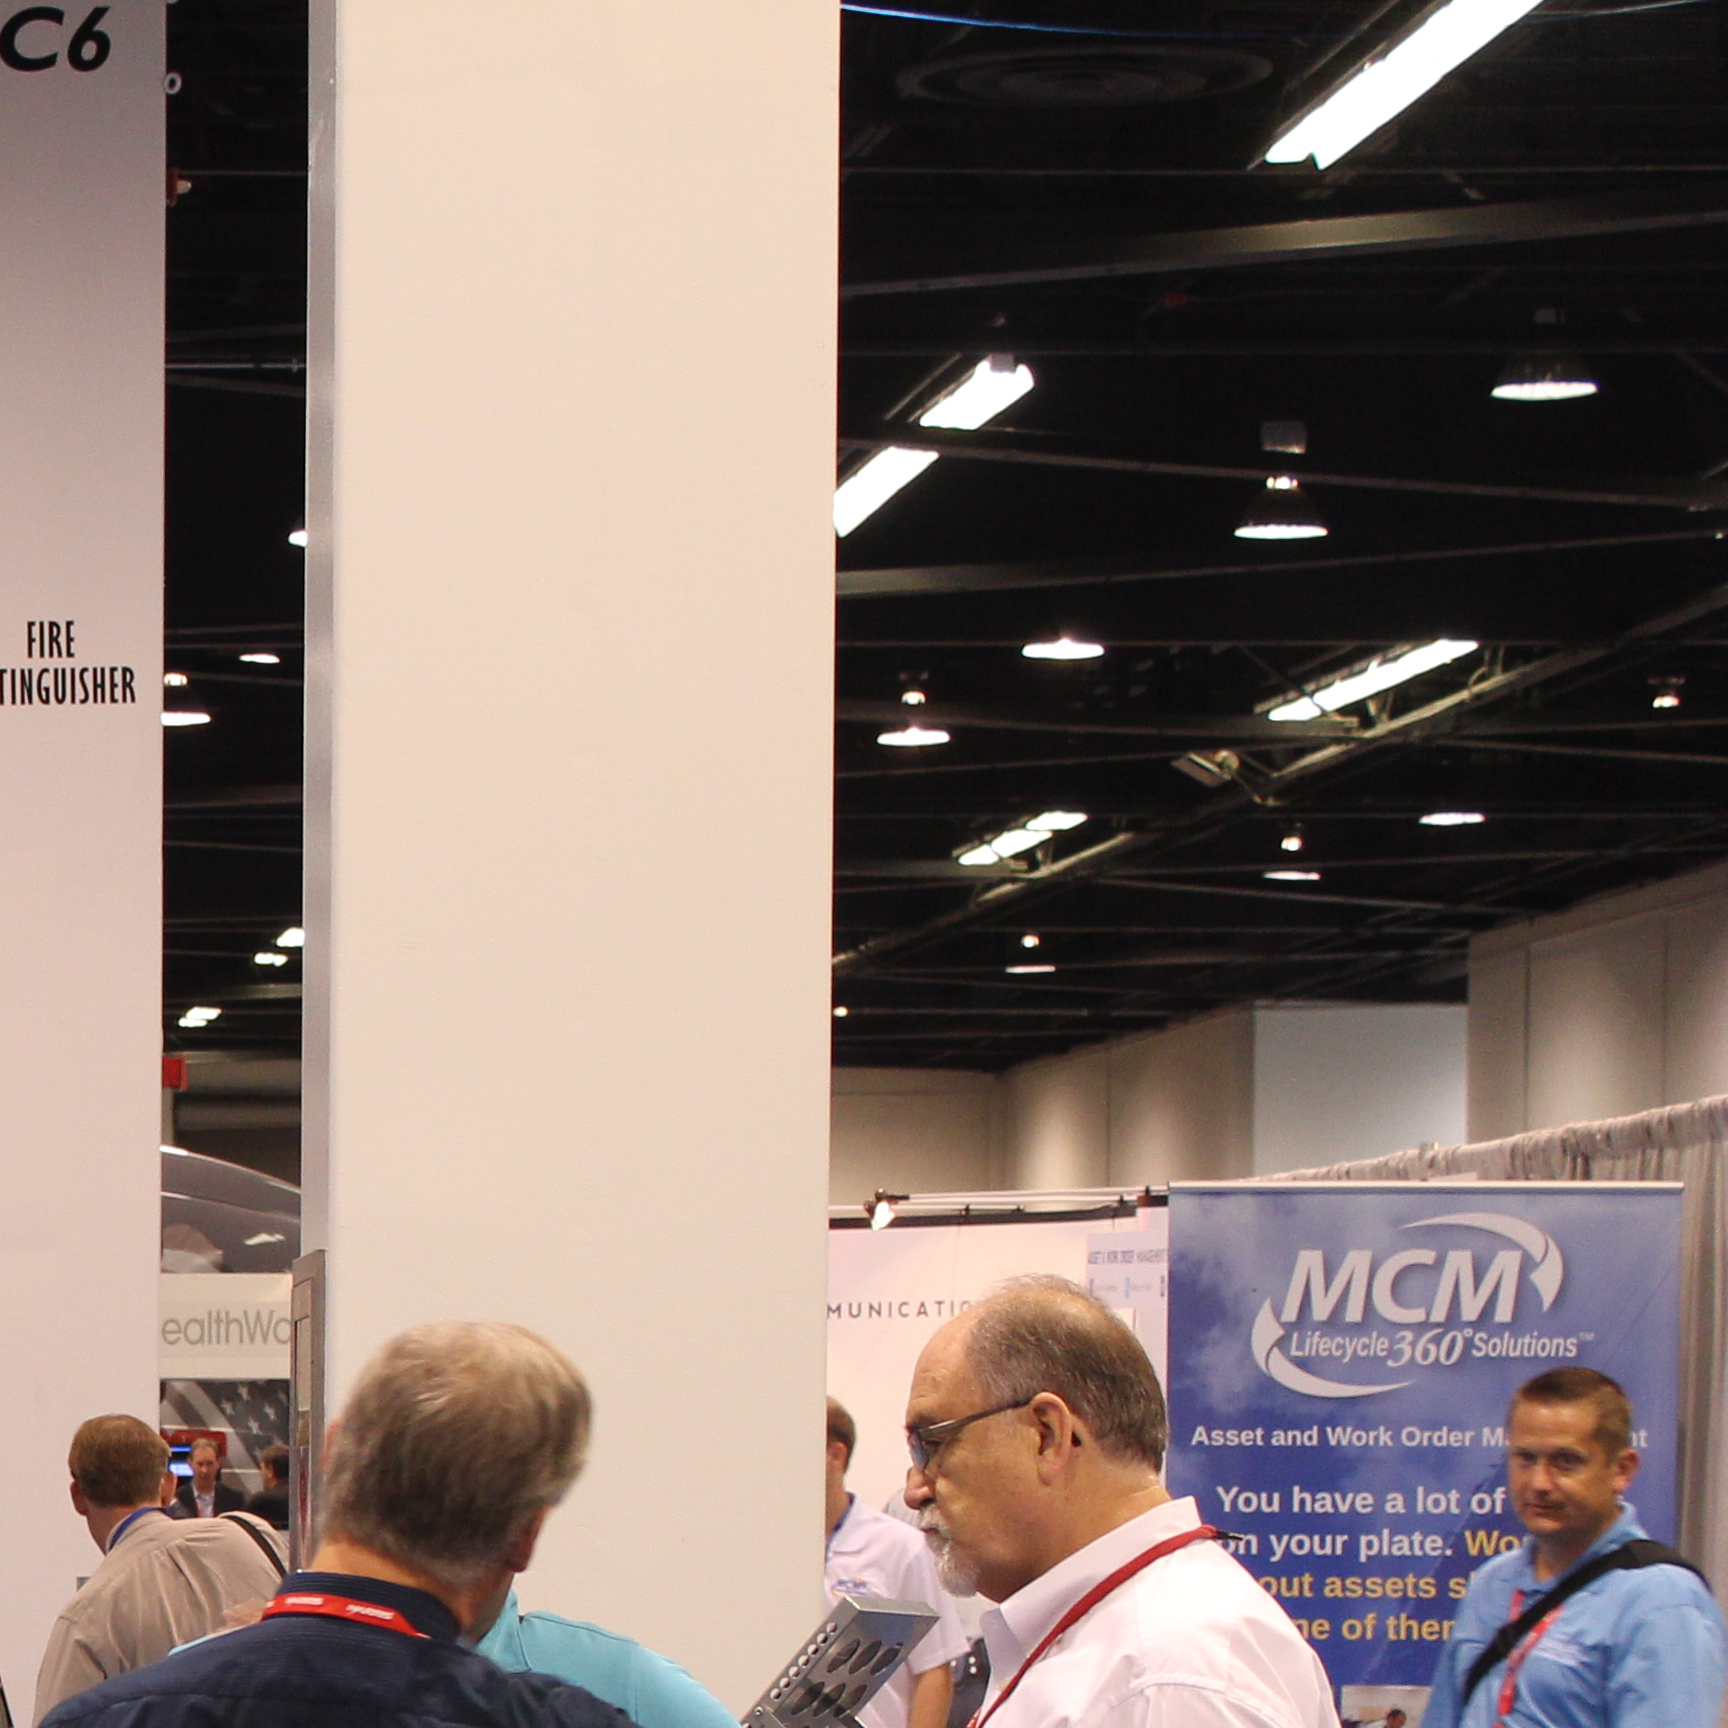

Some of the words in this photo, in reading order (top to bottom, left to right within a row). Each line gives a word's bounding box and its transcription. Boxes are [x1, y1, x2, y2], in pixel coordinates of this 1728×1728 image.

[26, 619, 75, 660] FIRE
[1279, 1249, 1523, 1325] MCM
[1290, 1330, 1389, 1363] Lifecycle
[1190, 1424, 1265, 1448] Asset
[1271, 1424, 1319, 1448] and
[1325, 1424, 1394, 1448] Work
[1399, 1424, 1476, 1448] Order
[1216, 1486, 1281, 1515] You
[1291, 1485, 1375, 1515] have
[1384, 1492, 1406, 1515] a
[1416, 1486, 1461, 1515] lot
[1470, 1486, 1506, 1515] of
[1270, 1533, 1349, 1563] your
[1359, 1528, 1454, 1564] plate.
[1324, 1573, 1437, 1599] assets
[1342, 1614, 1377, 1641] of
